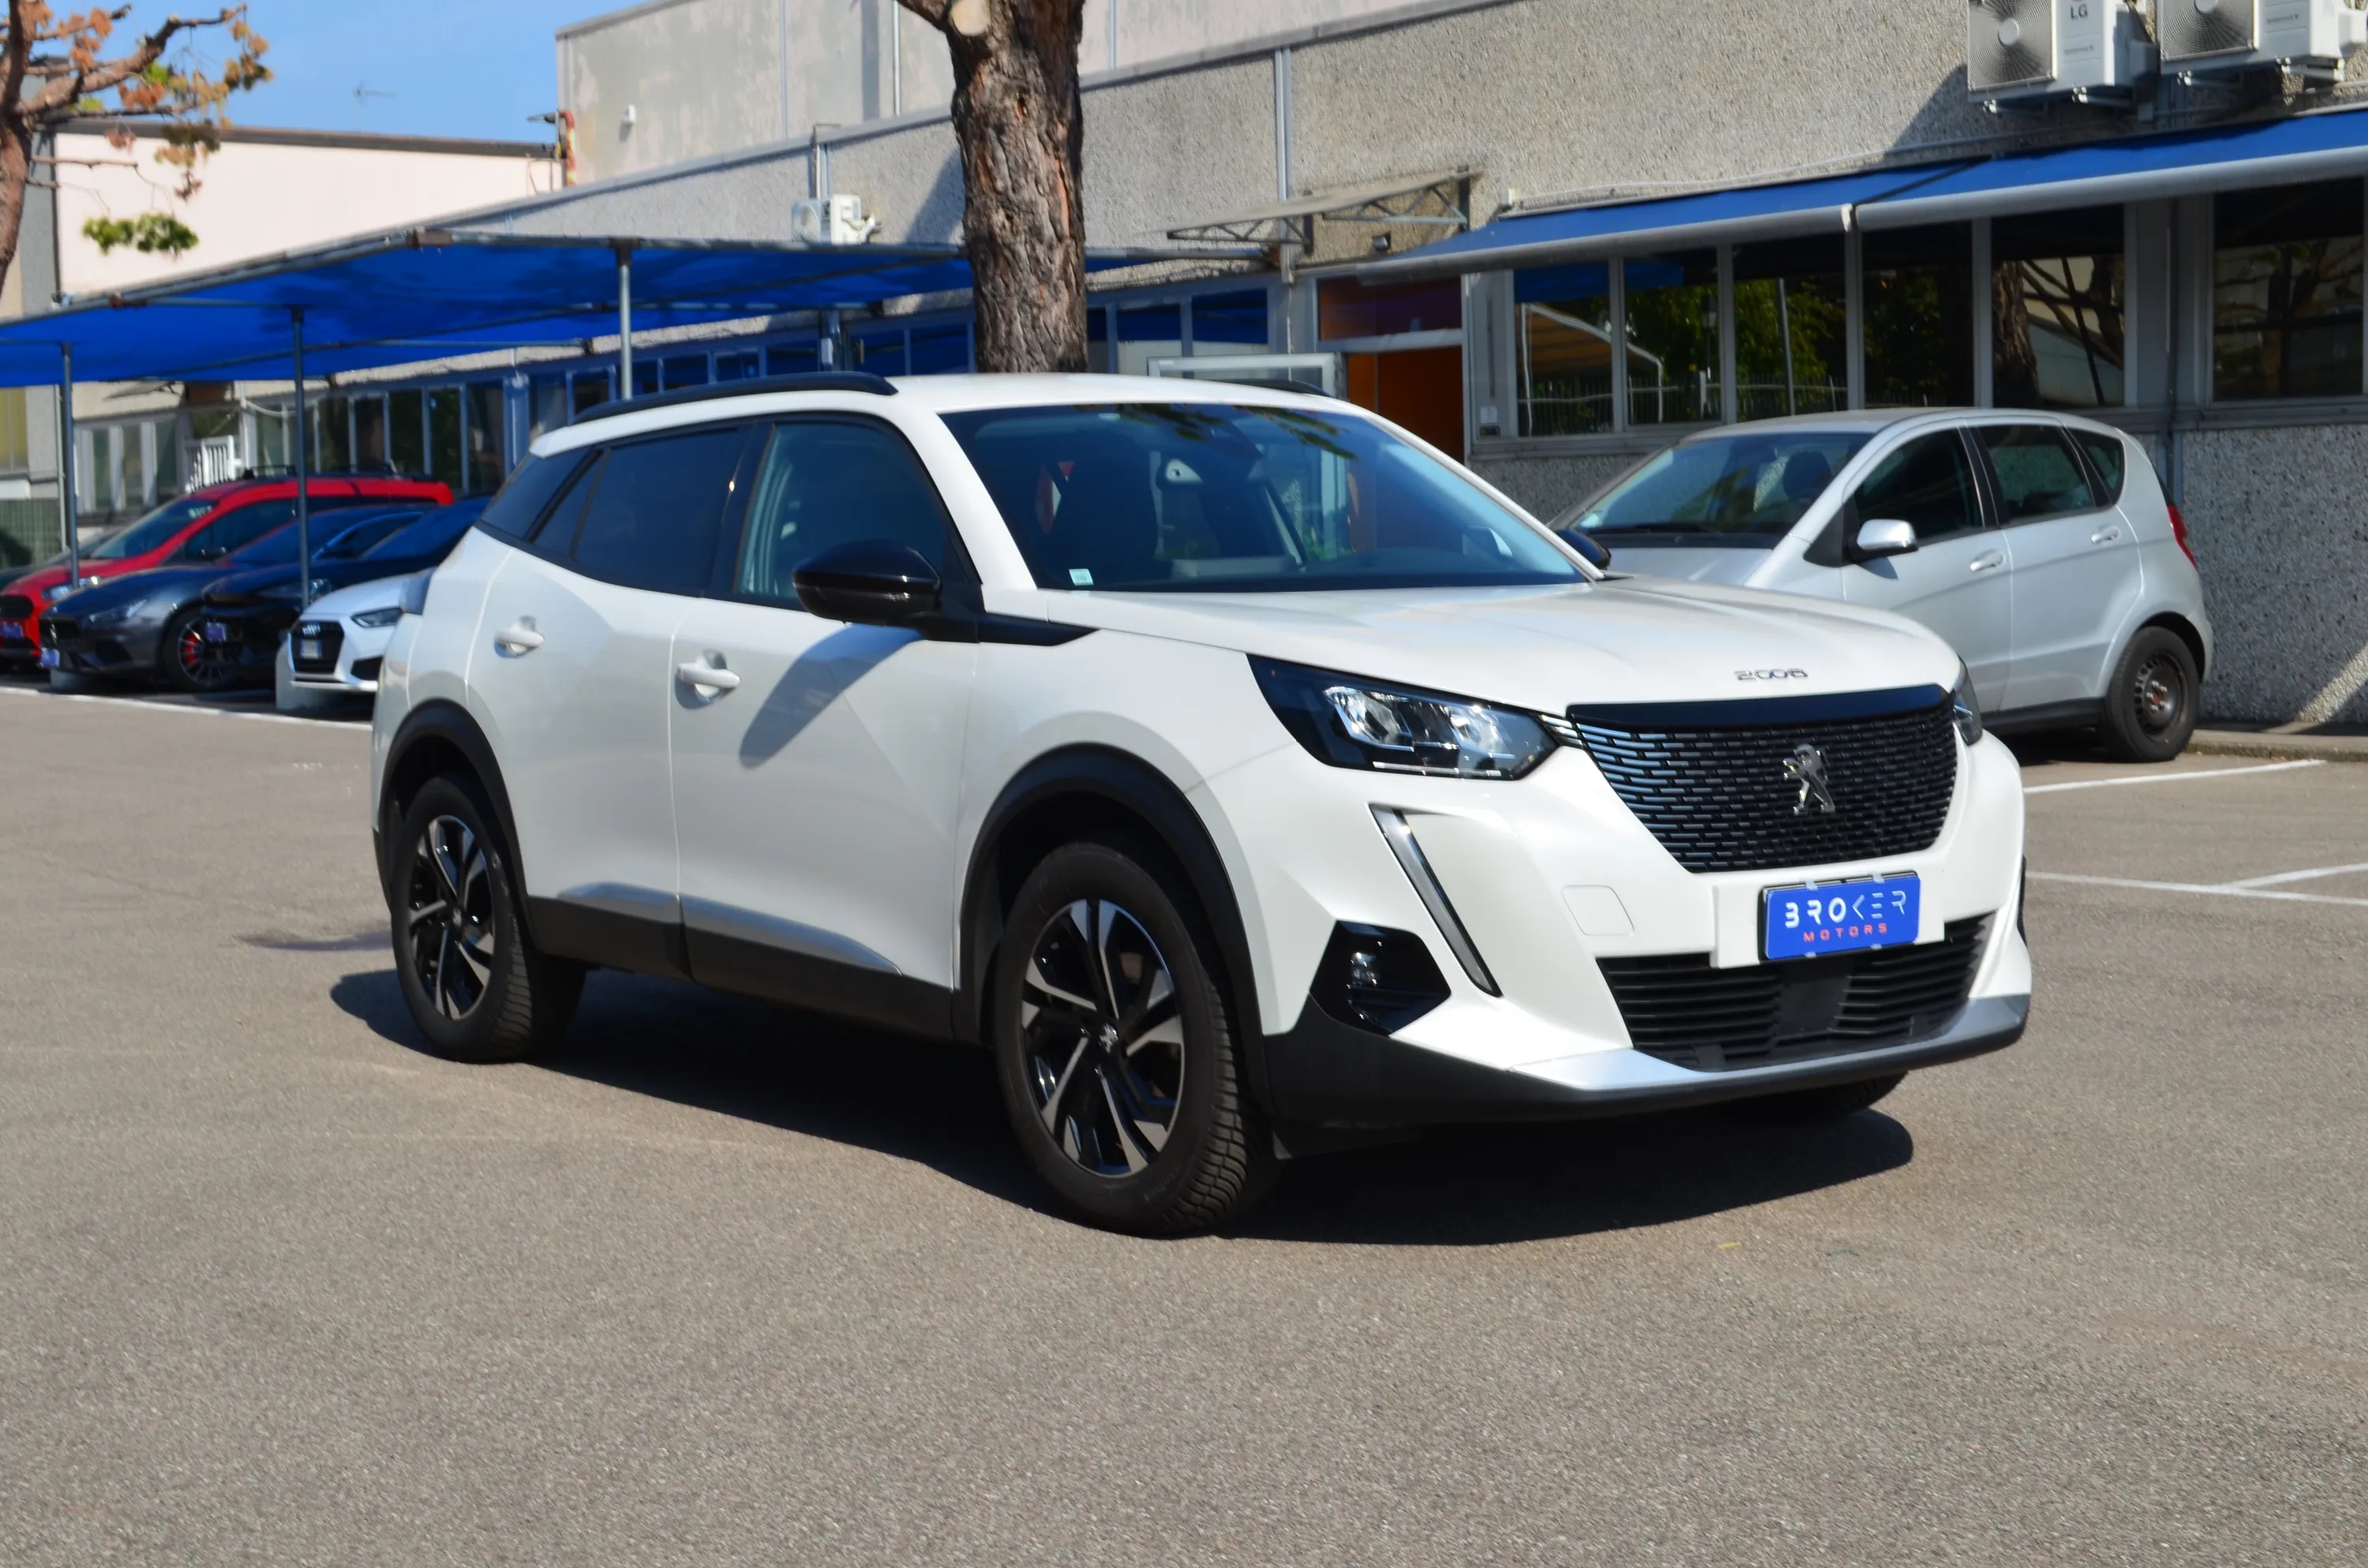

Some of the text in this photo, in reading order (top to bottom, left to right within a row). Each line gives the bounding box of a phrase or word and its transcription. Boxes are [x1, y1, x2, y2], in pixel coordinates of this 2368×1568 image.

[2070, 3, 2089, 21] LG
[1733, 668, 1808, 681] 2008
[1784, 889, 1907, 929] BROKER
[1802, 922, 1889, 943] MOTORS
